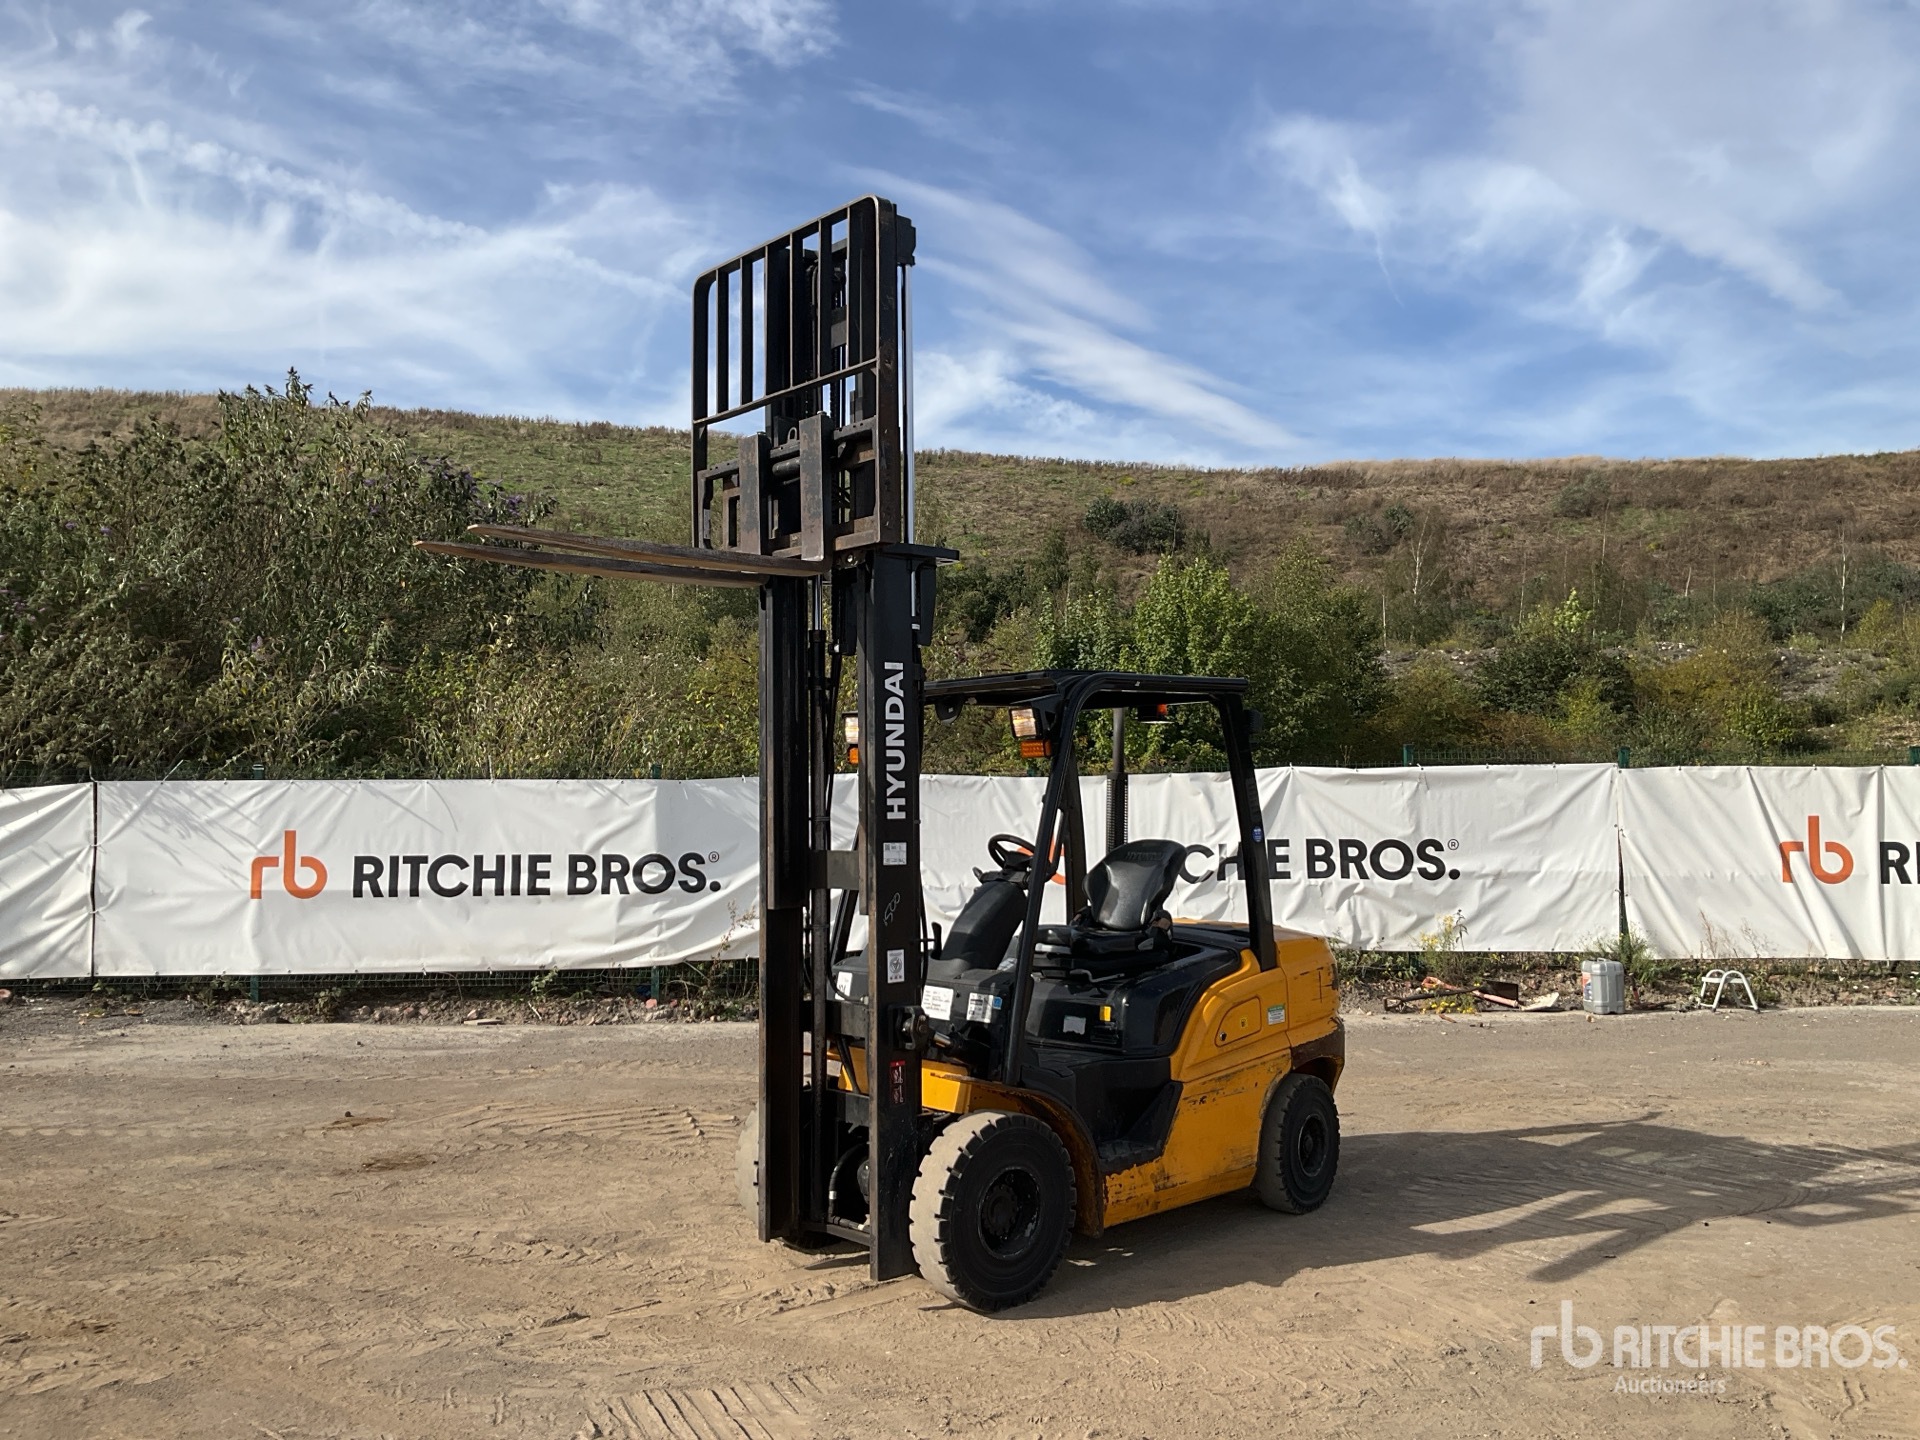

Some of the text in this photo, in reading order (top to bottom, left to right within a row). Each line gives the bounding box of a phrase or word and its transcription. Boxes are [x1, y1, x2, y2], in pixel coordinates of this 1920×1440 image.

[884, 661, 906, 820] HYUNDAI
[251, 829, 328, 899] rb
[353, 853, 552, 898] RITCHIE
[1779, 815, 1854, 884] rb
